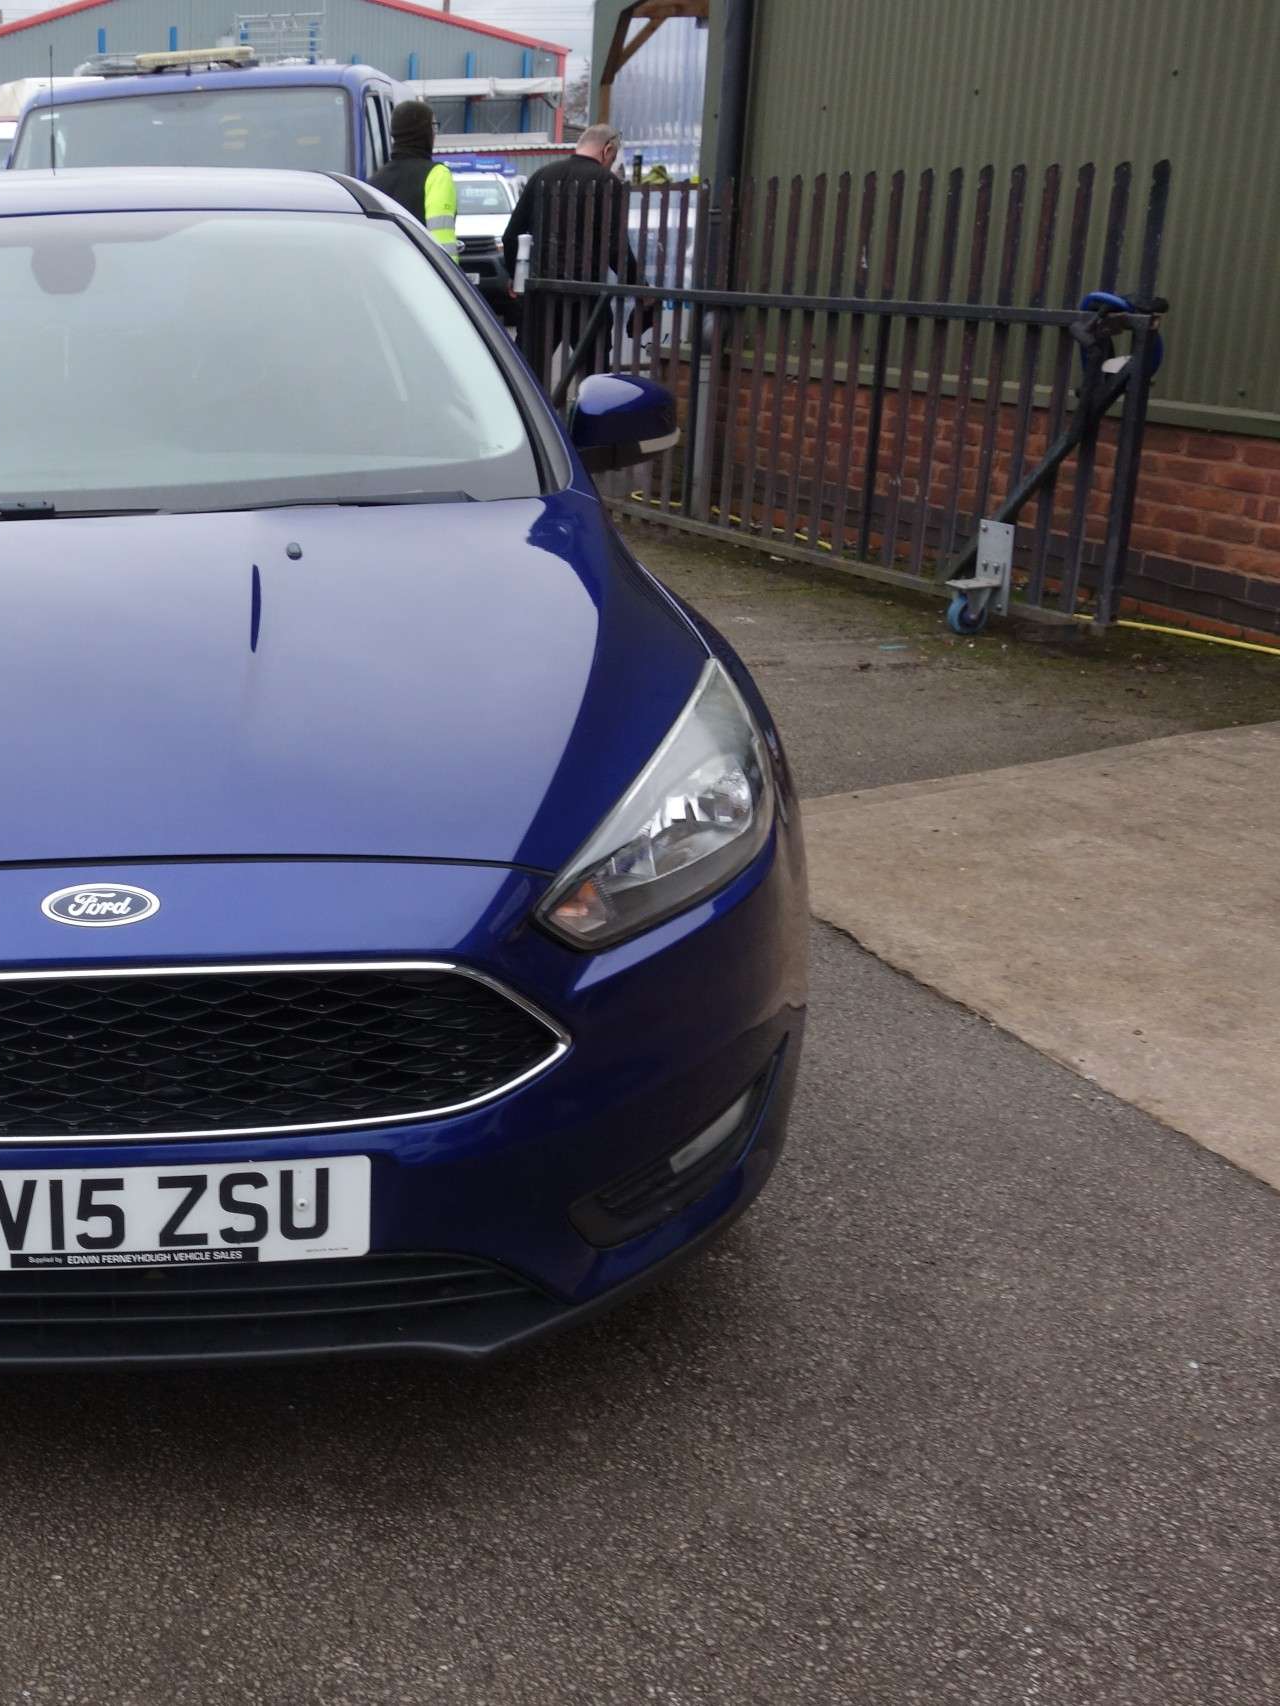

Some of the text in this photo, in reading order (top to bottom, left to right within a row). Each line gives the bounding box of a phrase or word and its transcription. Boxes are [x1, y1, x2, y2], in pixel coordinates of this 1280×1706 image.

[68, 893, 132, 916] Ford
[158, 1168, 329, 1247] ZSU
[67, 1255, 100, 1264] EDWIN
[101, 1253, 171, 1264] FERNEYHOUGH
[173, 1252, 209, 1262] VEHICLE
[212, 1250, 243, 1260] SALES
